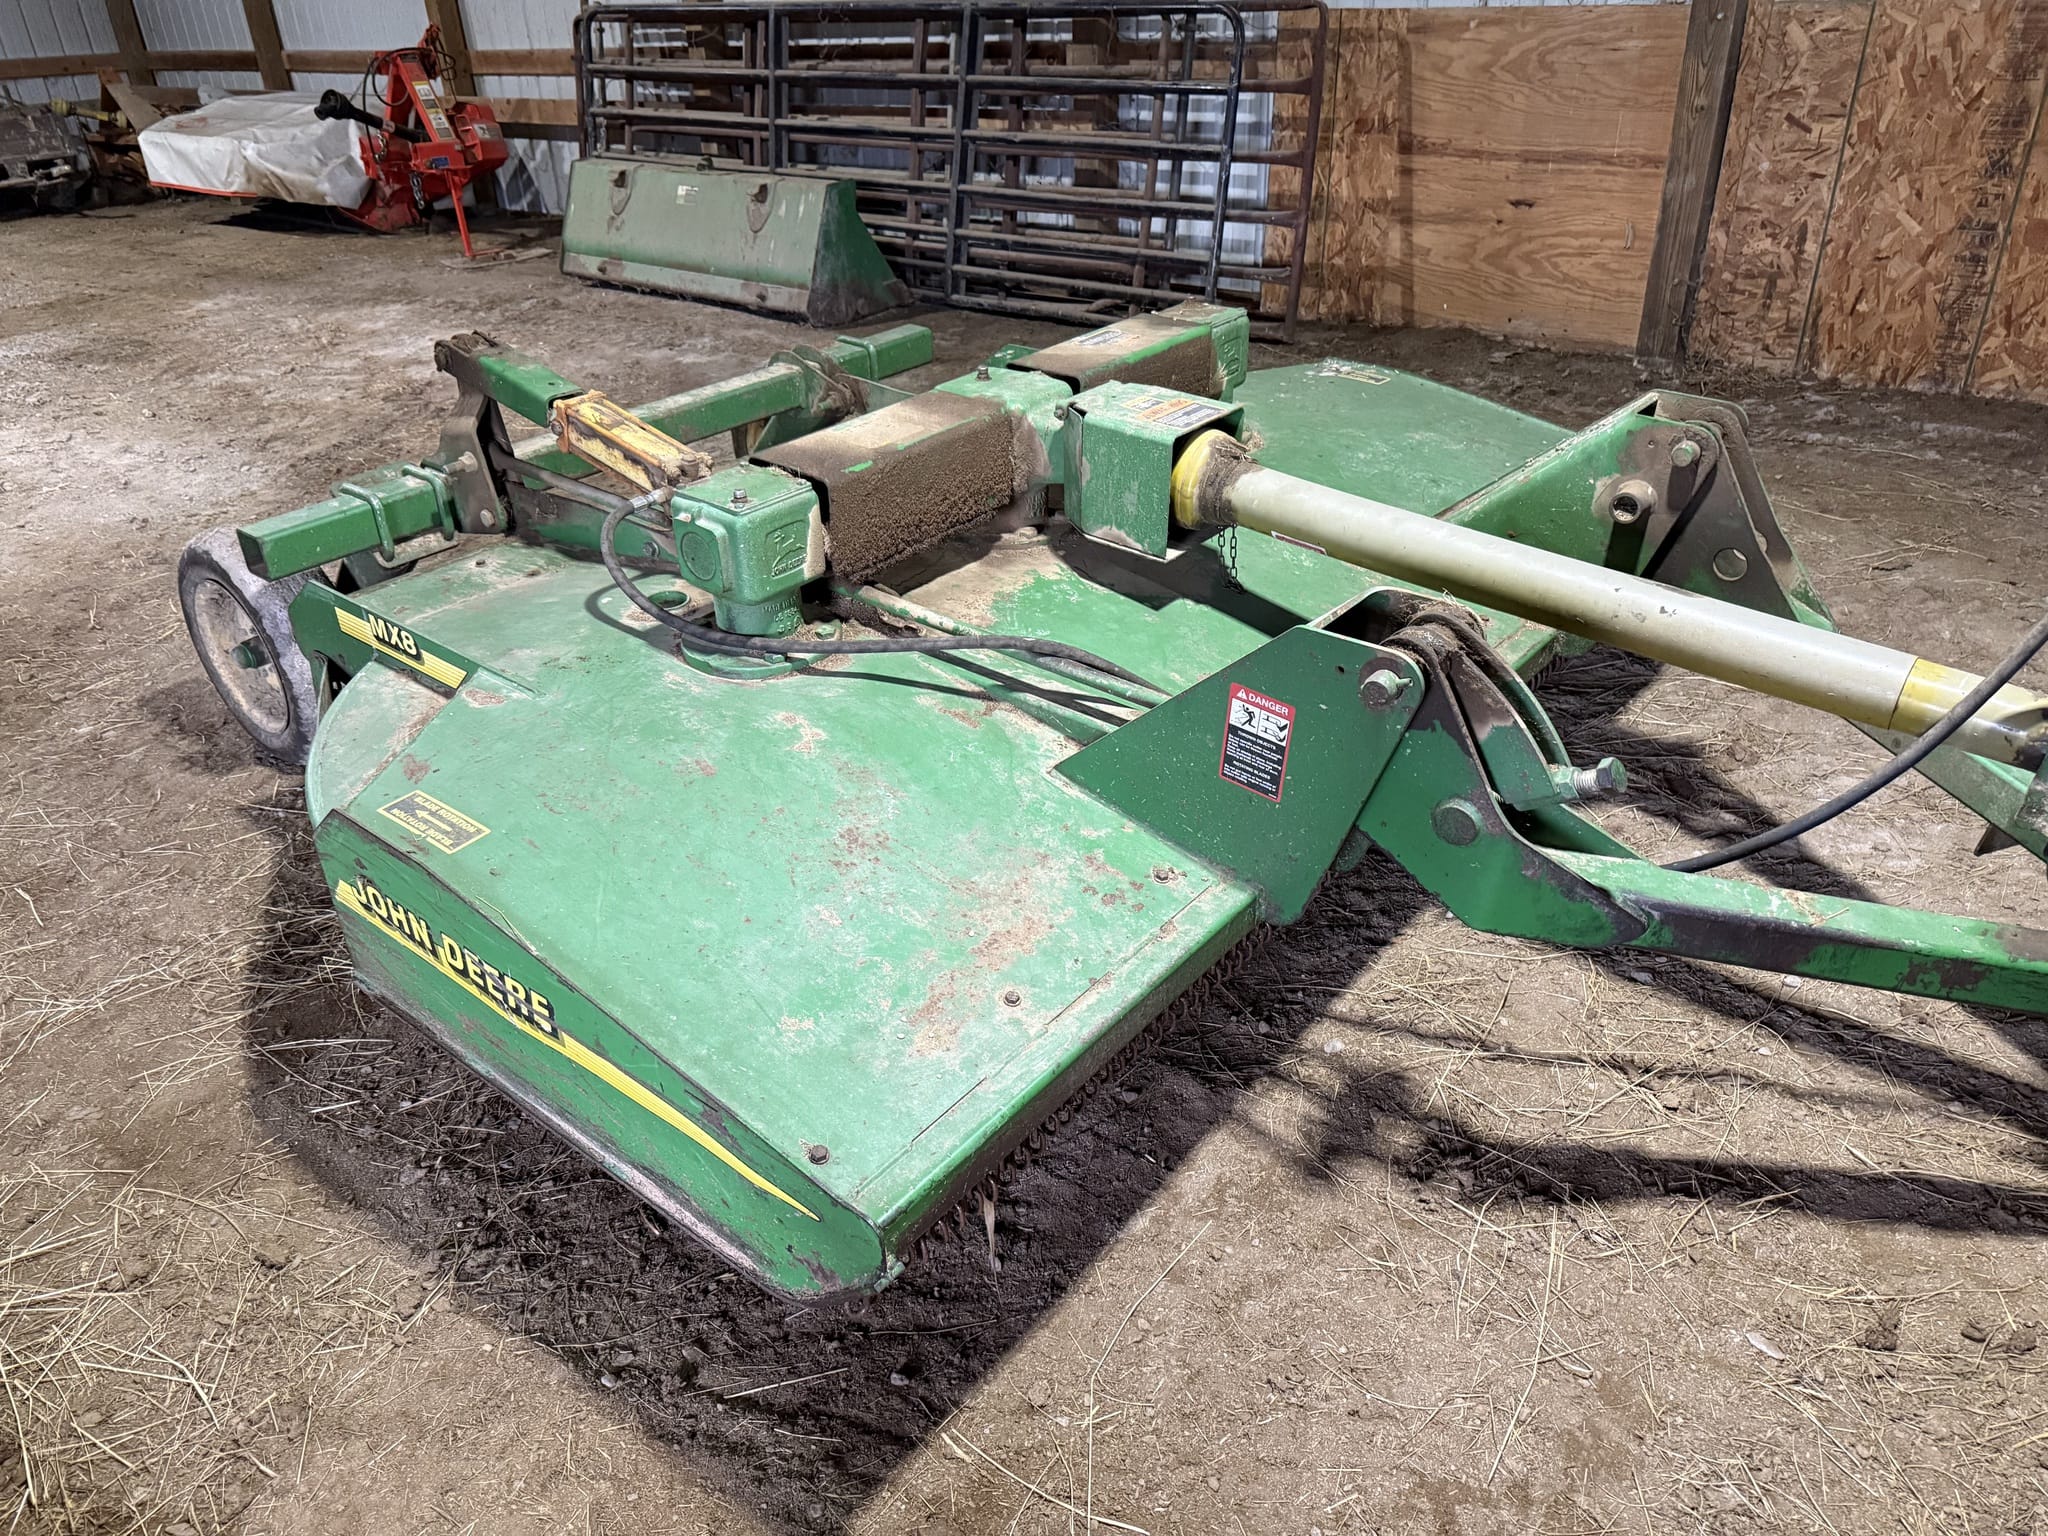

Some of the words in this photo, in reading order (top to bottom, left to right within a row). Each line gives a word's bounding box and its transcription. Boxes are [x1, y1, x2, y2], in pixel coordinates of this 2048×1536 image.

[368, 613, 418, 656] MX8
[1248, 692, 1289, 716] DANGER
[1233, 760, 1254, 773] ROTATING
[1253, 769, 1270, 780] BLADES
[390, 807, 429, 831] ROTATION
[413, 796, 441, 812] BLADE
[436, 808, 478, 833] ROTATION
[425, 828, 454, 846] BLADE
[351, 876, 434, 953] JOHN
[441, 932, 554, 1034] DEERE
